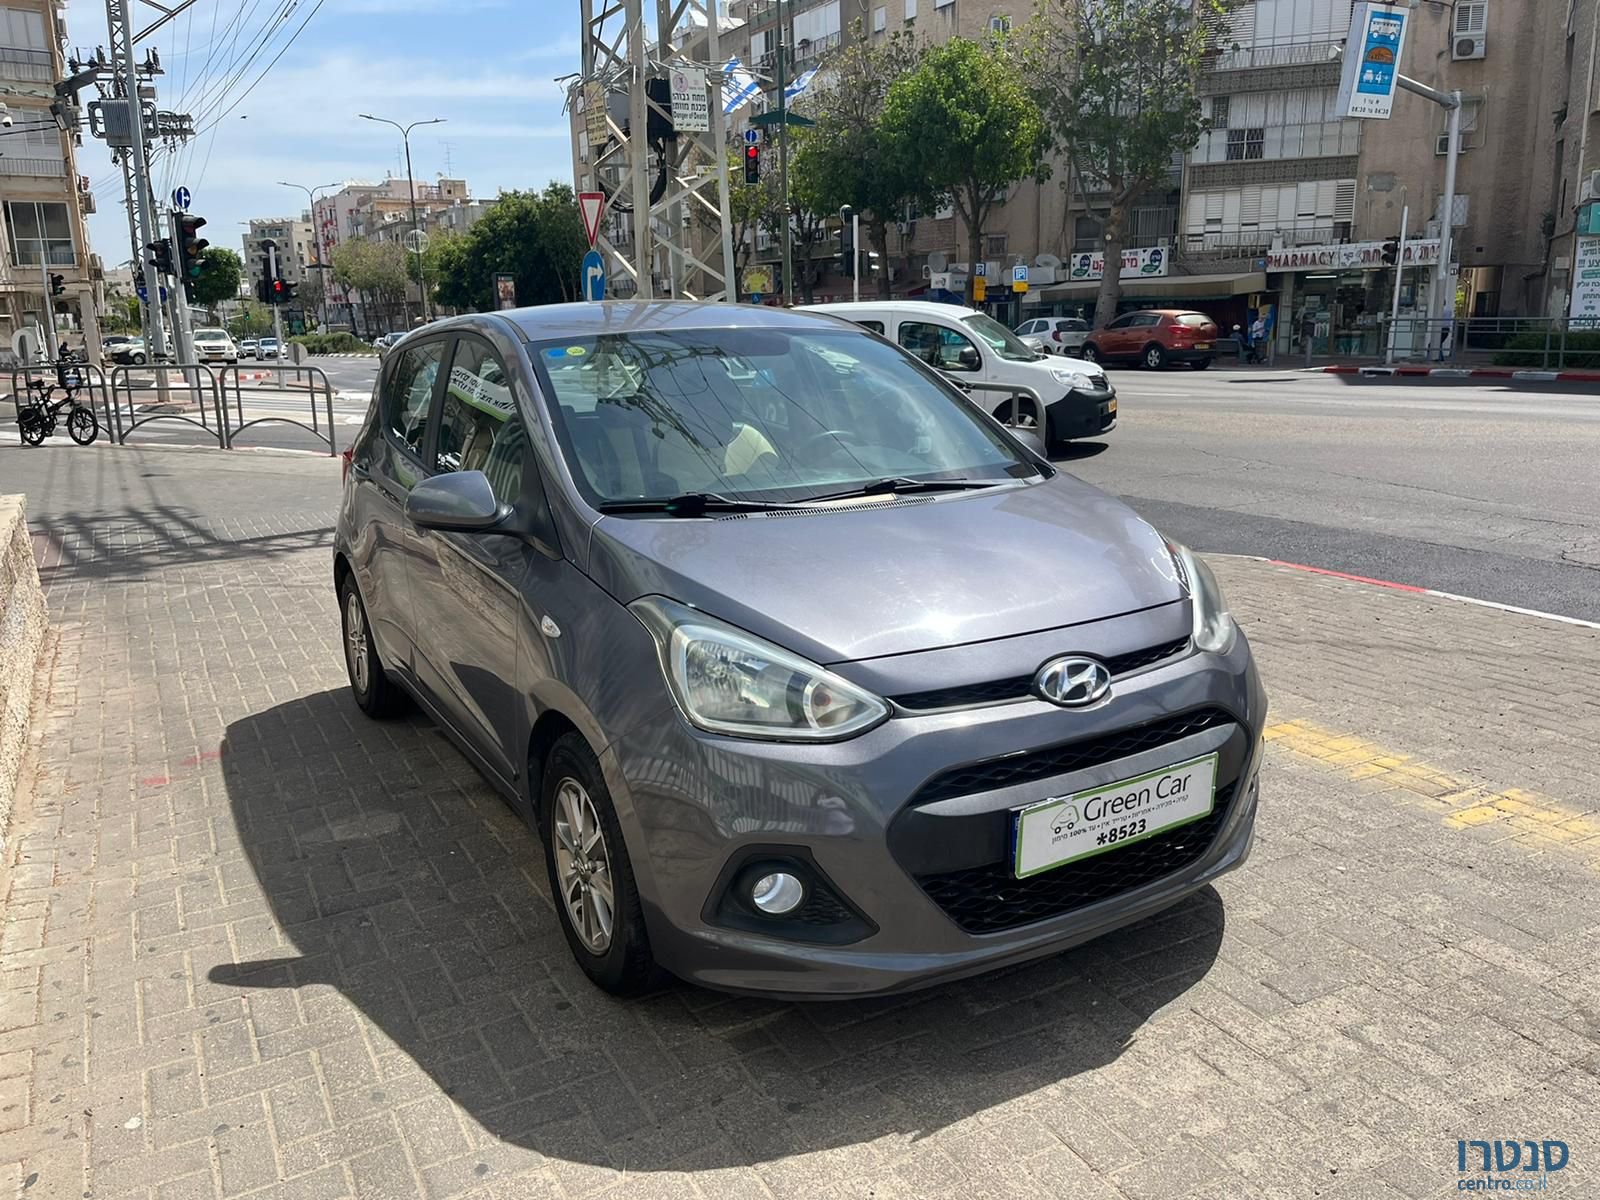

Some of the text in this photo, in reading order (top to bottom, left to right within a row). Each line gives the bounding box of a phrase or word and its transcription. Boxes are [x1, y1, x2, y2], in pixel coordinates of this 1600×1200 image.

[692, 94, 705, 102] מתח
[691, 103, 706, 112] סכנת
[673, 111, 689, 120] Danger
[1266, 251, 1335, 268] PHARMACY
[1084, 774, 1191, 822] Green Car
[1132, 807, 1152, 818] אחריות
[1101, 820, 1110, 829] אין
[1069, 828, 1087, 838] 100%
[1052, 833, 1068, 845] מימון
